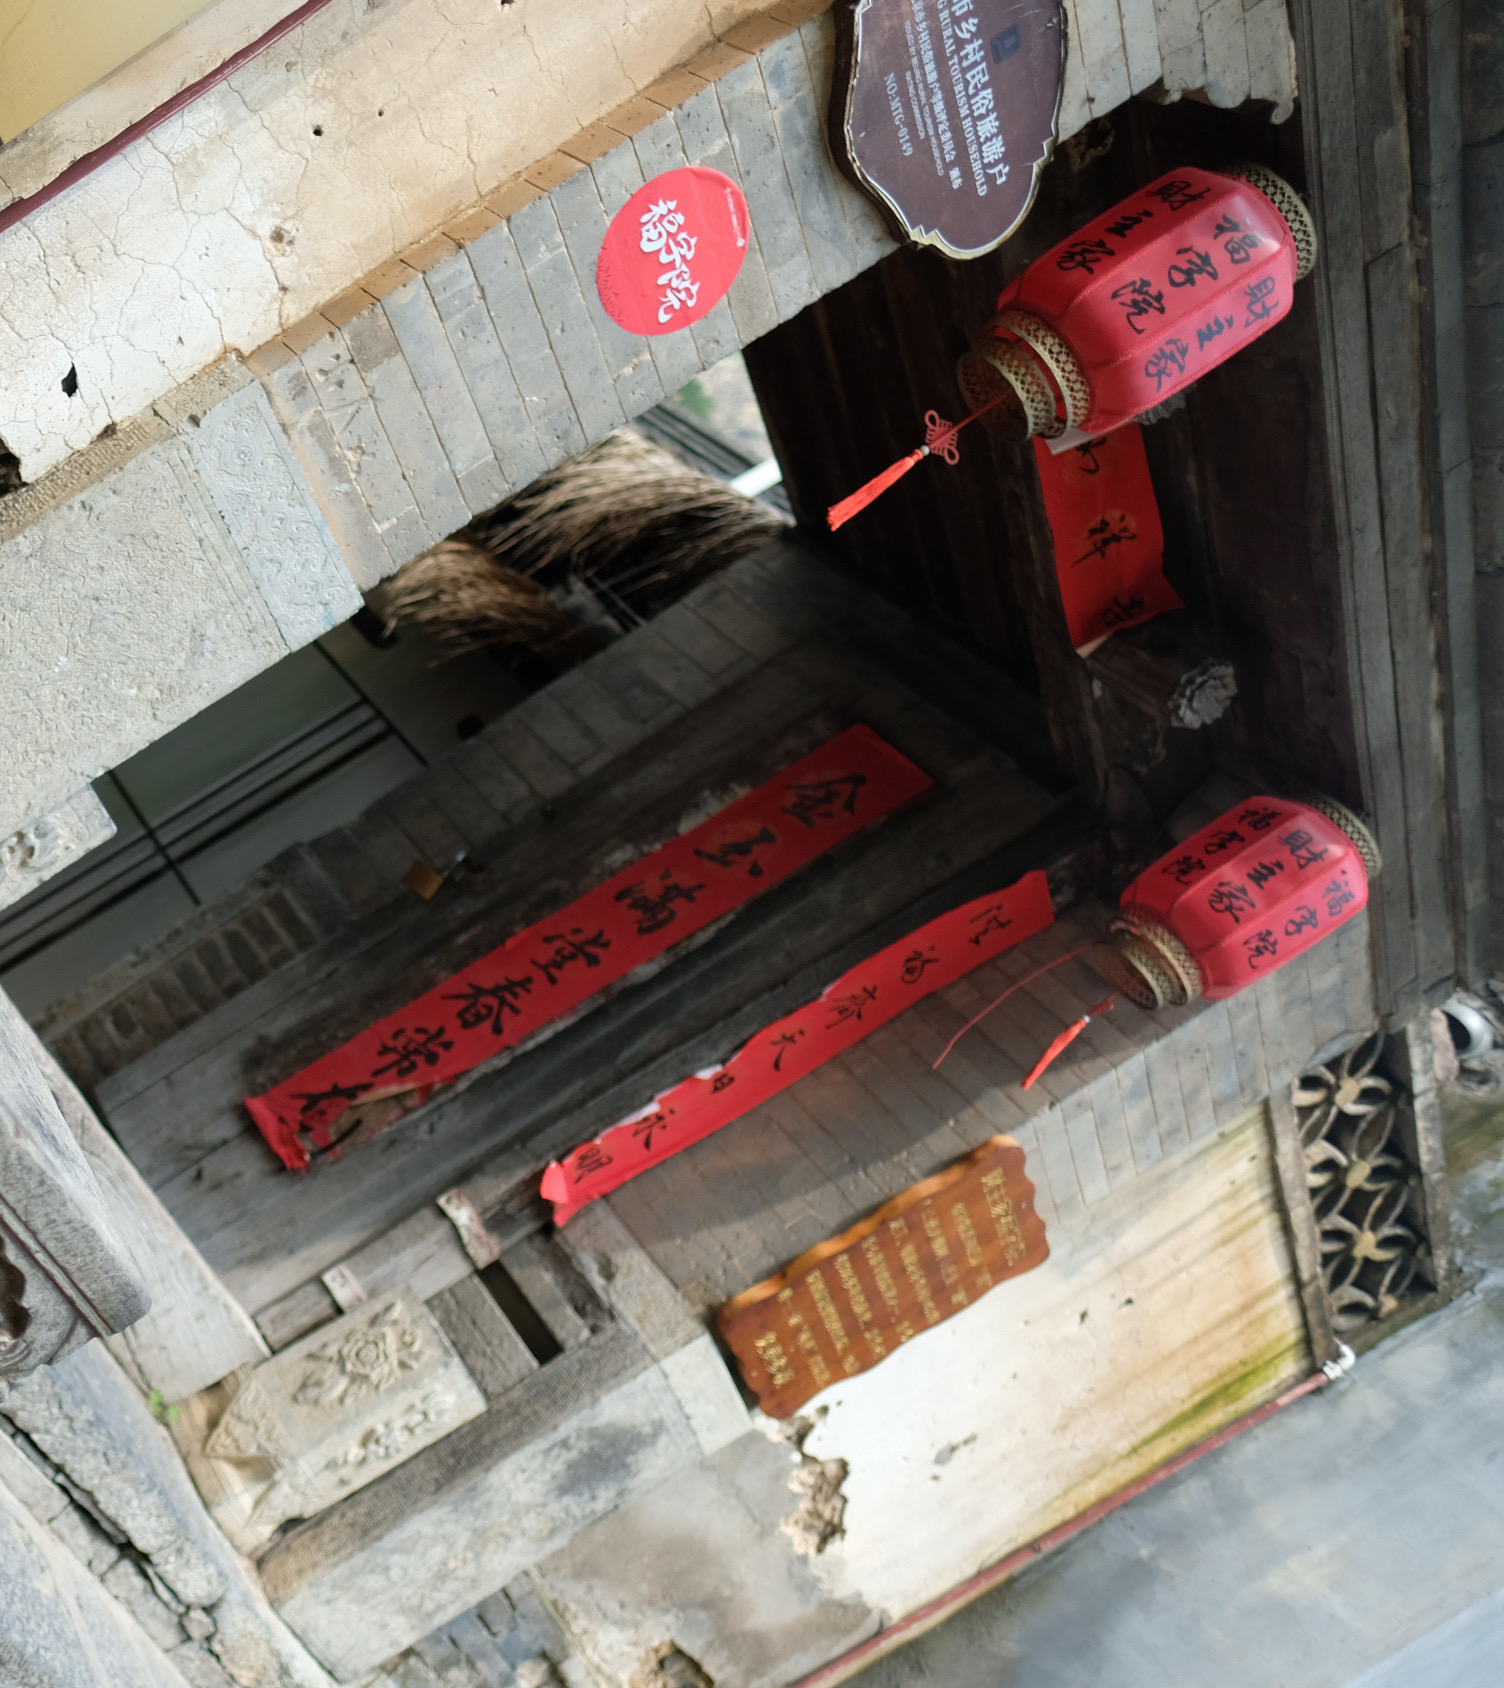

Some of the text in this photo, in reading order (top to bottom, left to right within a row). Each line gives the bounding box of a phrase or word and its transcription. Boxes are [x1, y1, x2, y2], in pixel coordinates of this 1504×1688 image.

[939, 9, 956, 57] RURAL
[948, 54, 970, 118] TOURISM
[962, 116, 988, 197] HOUSEHOLD
[639, 198, 701, 324] 福字院
[1111, 213, 1263, 335] 福字院
[1162, 807, 1282, 885] 福字院
[1243, 874, 1355, 970] 福字院
